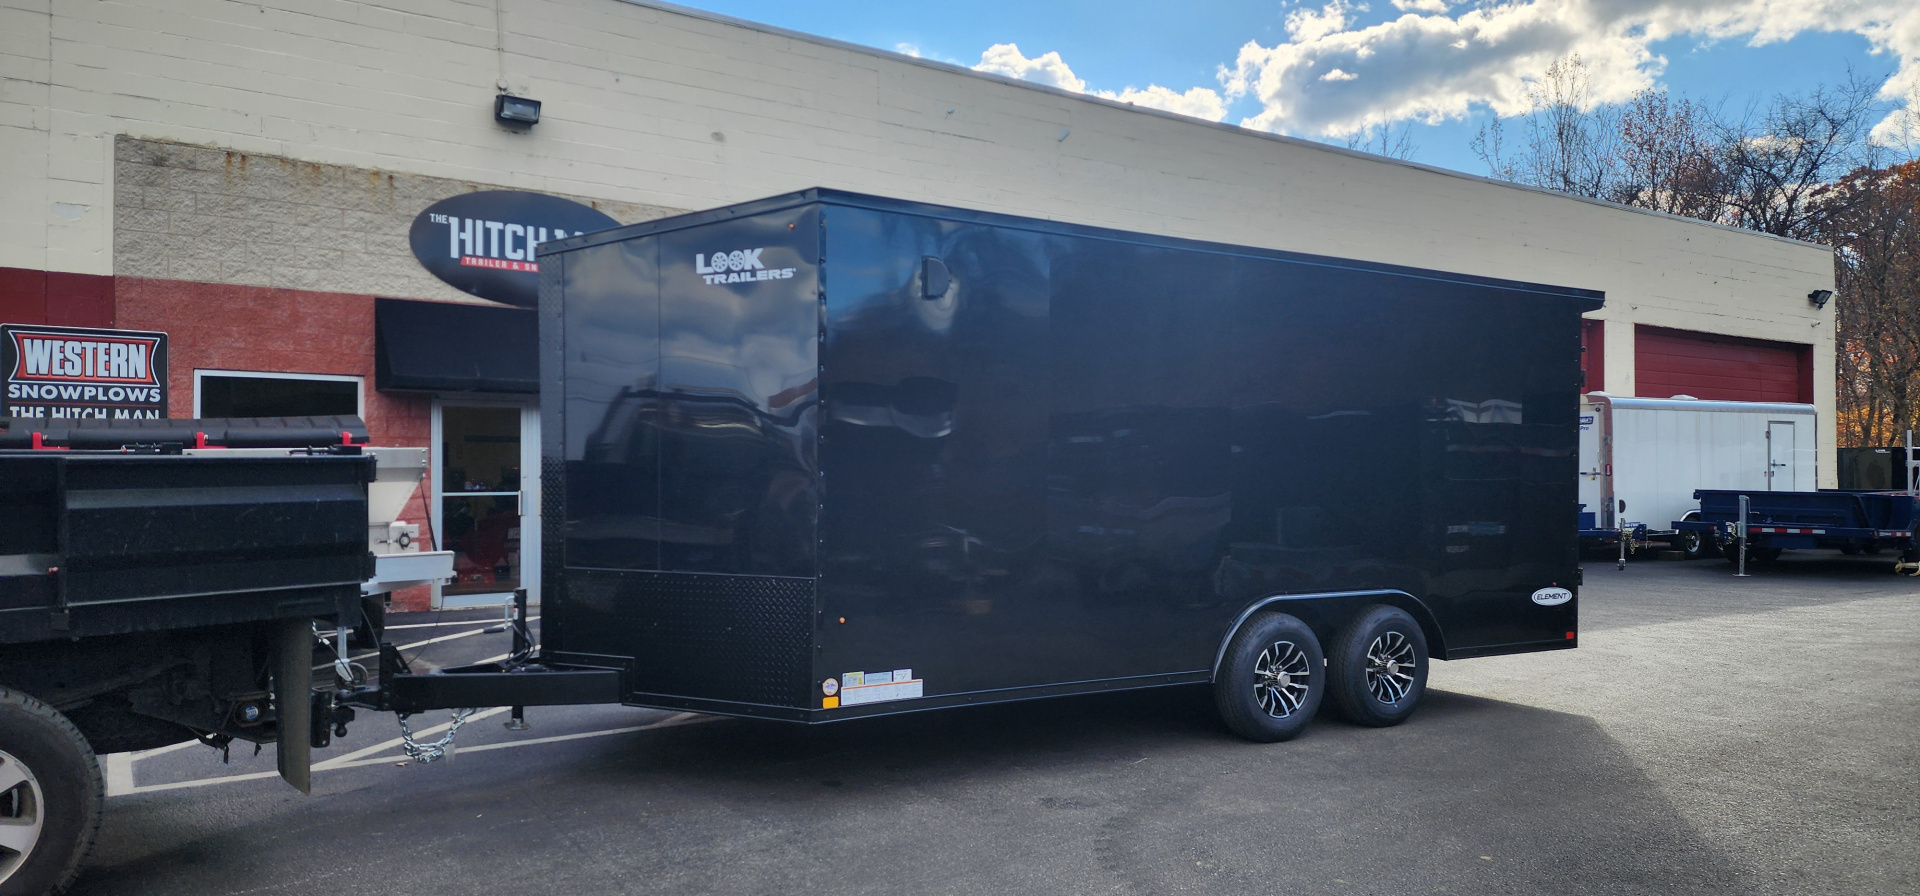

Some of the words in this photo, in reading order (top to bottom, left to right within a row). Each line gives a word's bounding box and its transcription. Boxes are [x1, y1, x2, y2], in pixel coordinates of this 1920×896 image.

[429, 213, 448, 224] THE
[449, 216, 547, 262] HITCH
[465, 257, 508, 268] TRAILER
[512, 261, 519, 270] &
[524, 263, 538, 271] SN
[695, 248, 765, 274] LOOK
[702, 268, 794, 285] TRAILERS
[23, 338, 147, 379] WESTERN
[8, 383, 161, 403] SNOWPLOWS
[9, 406, 45, 418] THE
[52, 406, 107, 419] HITCH
[114, 408, 160, 419] MAN
